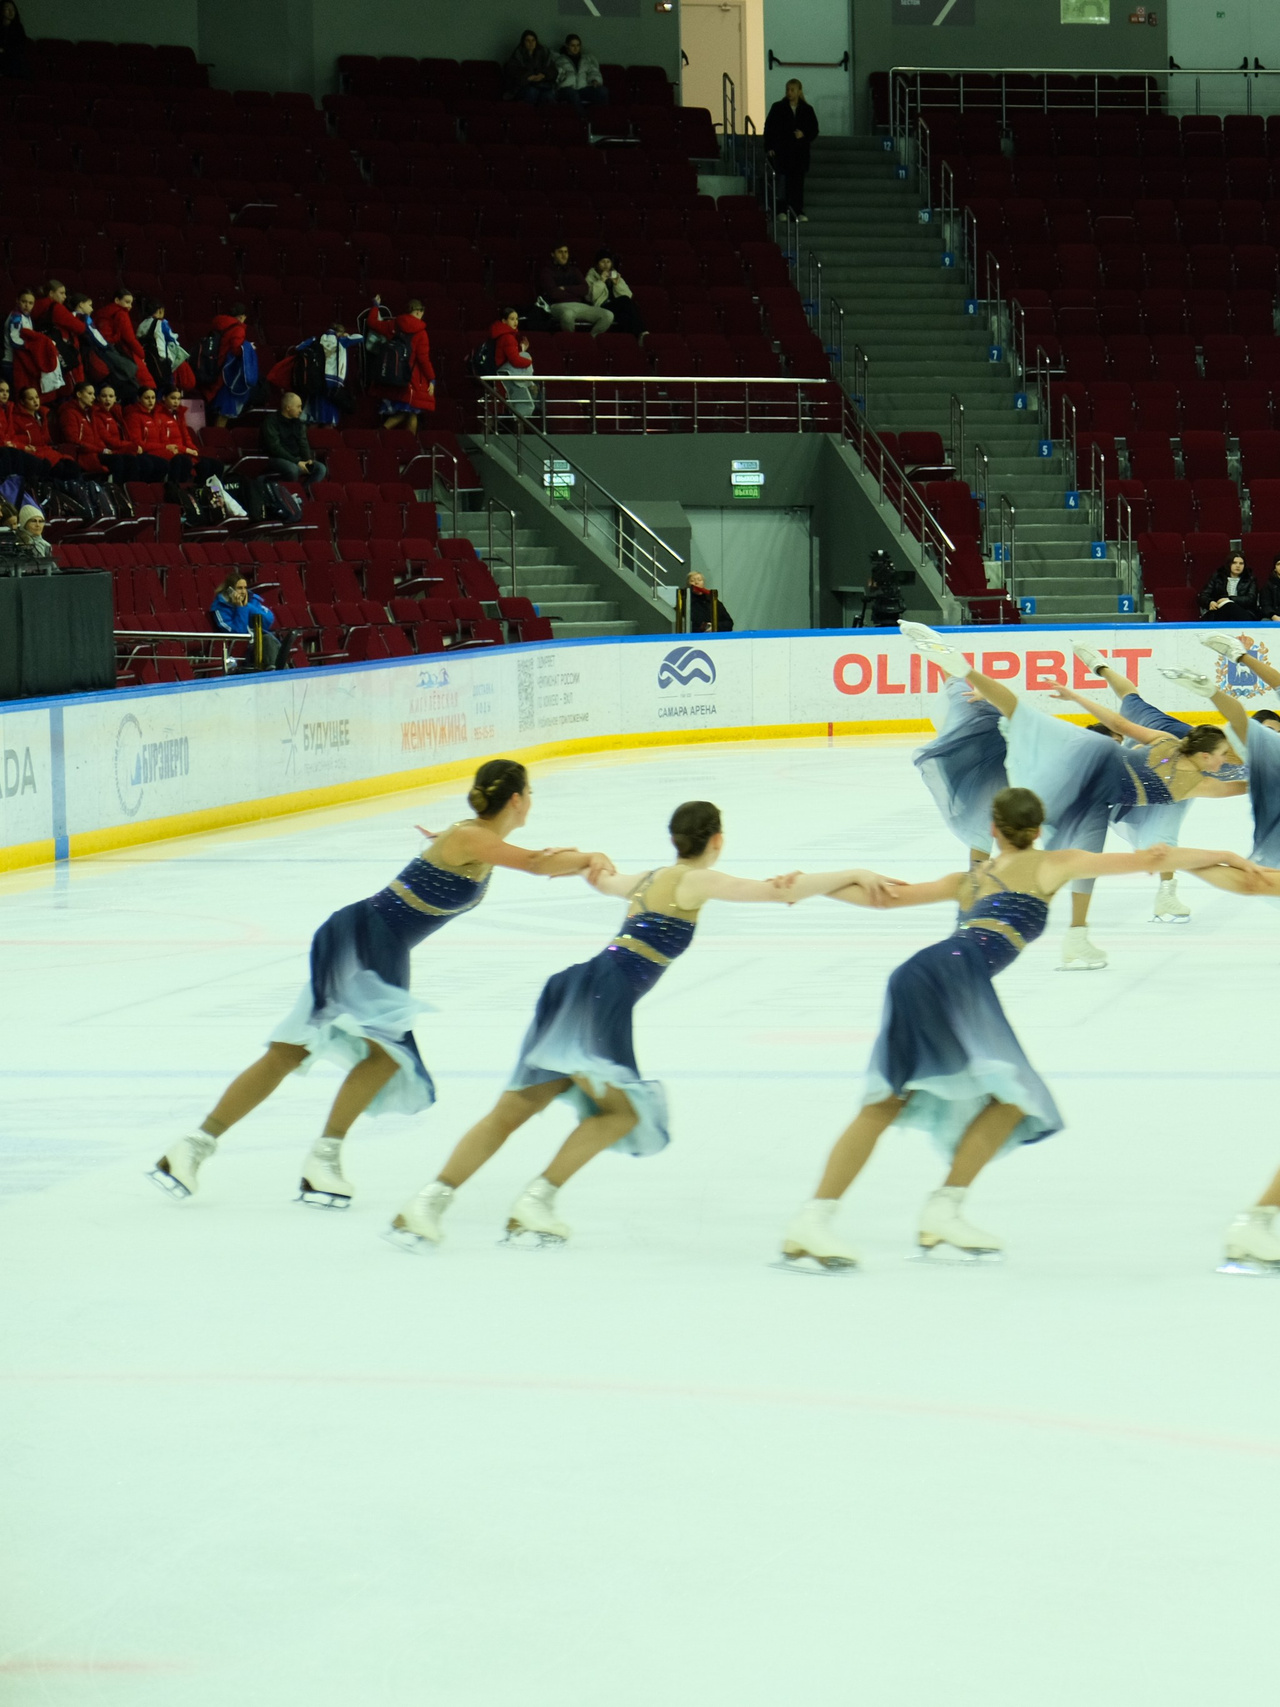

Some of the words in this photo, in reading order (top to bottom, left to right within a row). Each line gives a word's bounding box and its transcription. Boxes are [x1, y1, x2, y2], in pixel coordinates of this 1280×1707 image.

[658, 706, 688, 719] САМАРА
[690, 704, 717, 716] АРЕНА
[303, 719, 350, 755] БУДУЩЕЕ
[0, 746, 37, 798] DA
[142, 735, 190, 784] БУРЭНЕРГО
